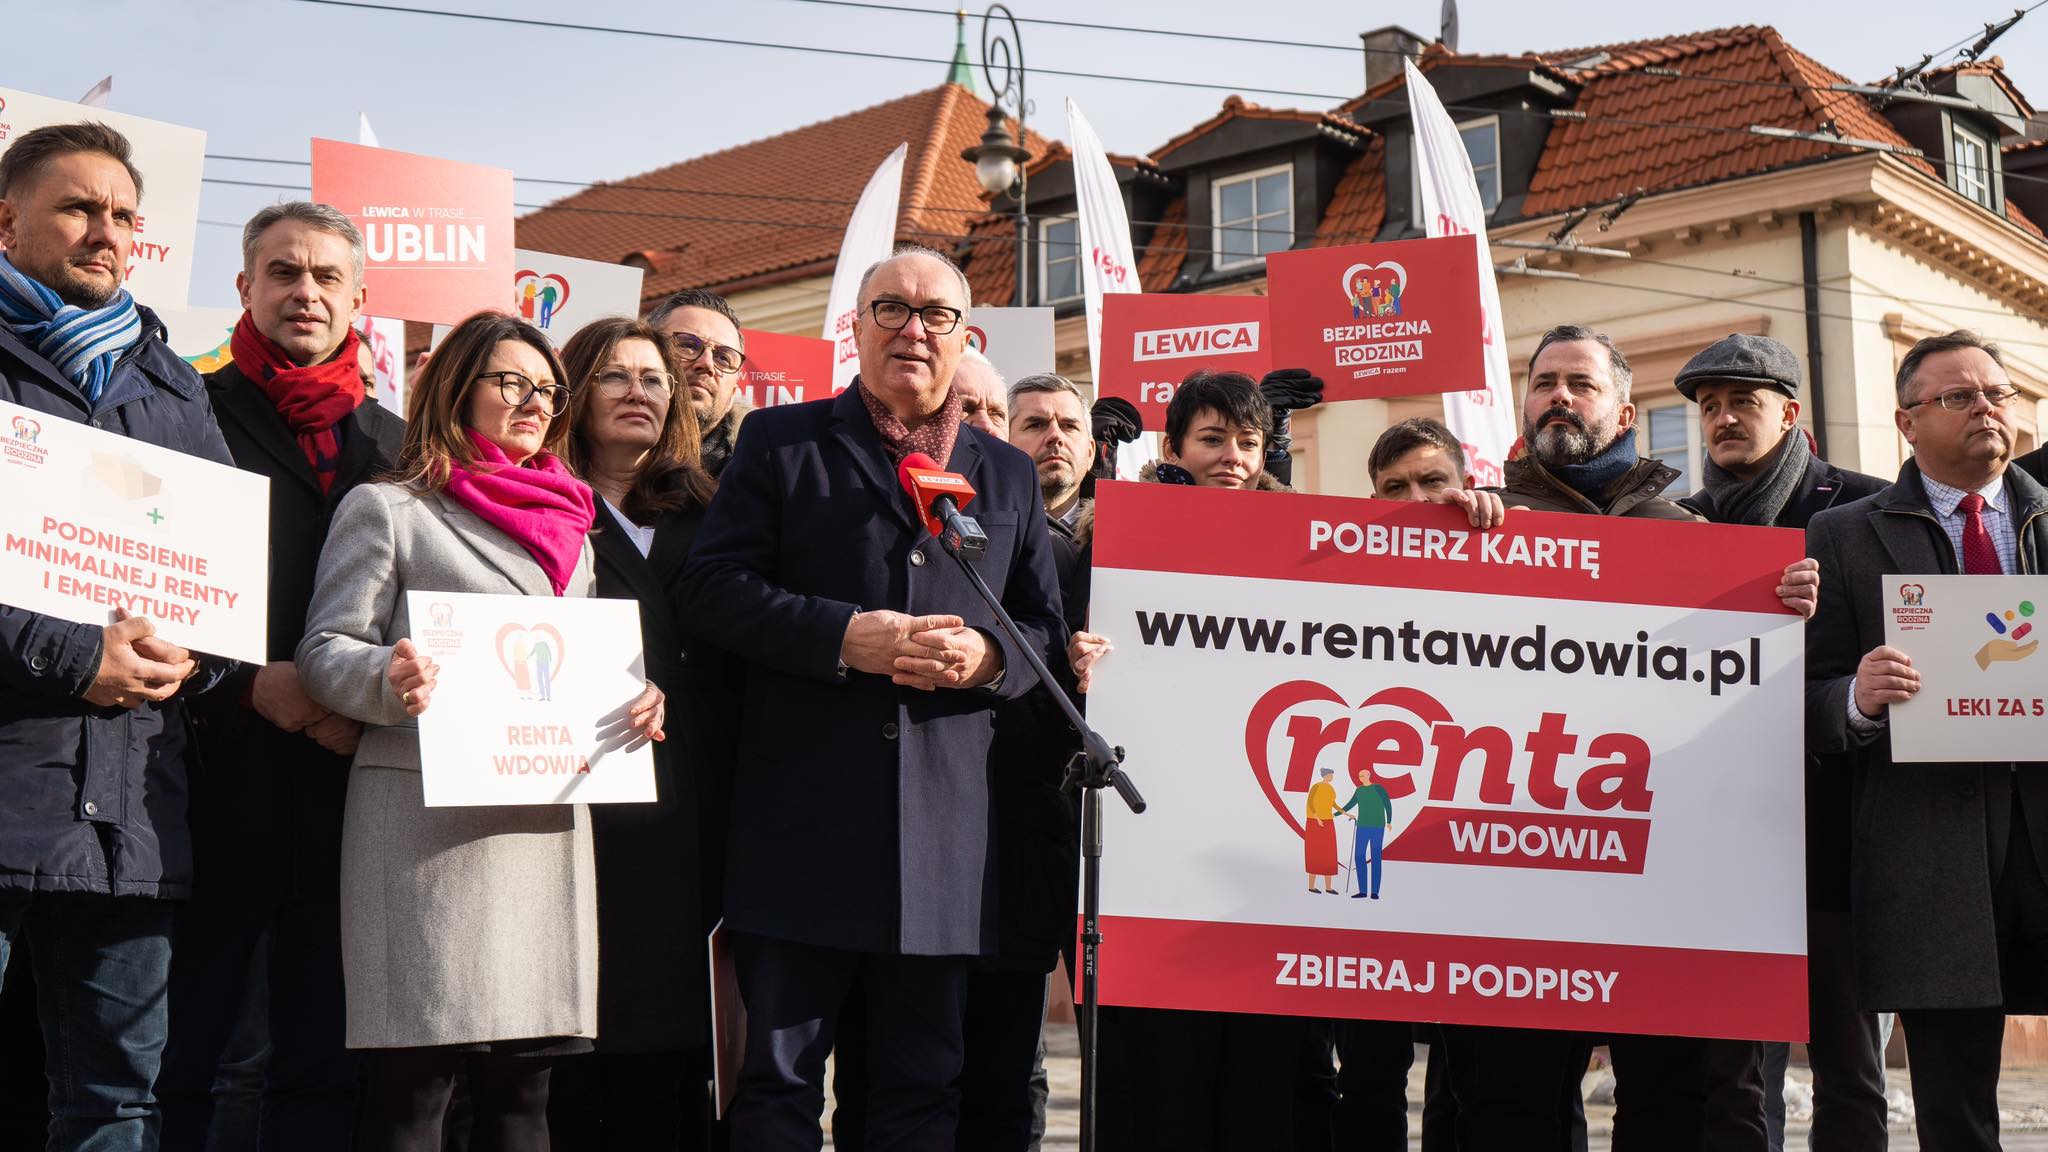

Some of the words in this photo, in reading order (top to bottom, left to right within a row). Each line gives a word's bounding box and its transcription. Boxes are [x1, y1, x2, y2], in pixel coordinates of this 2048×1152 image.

[362, 206, 409, 218] LEWICA
[412, 207, 425, 219] W
[429, 207, 465, 219] TRASIE
[130, 240, 170, 263] NTY
[366, 223, 486, 262] UBLIN
[1141, 327, 1252, 356] LEWICA
[1323, 319, 1432, 342] BEZPIECZNA
[1339, 343, 1420, 363] RODZINA
[750, 371, 787, 382] TRASIE
[1355, 368, 1379, 378] LEWICA
[1383, 366, 1407, 375] razem
[1140, 381, 1180, 403] ra
[42, 516, 208, 577] PODNIESIENIE
[1309, 520, 1469, 561] POBIERZ
[1481, 532, 1600, 579] KARTĘ
[6, 533, 157, 589] MINIMALNEJ
[164, 575, 239, 609] RENTY
[43, 571, 50, 589] I
[58, 574, 201, 626] EMERYTURY
[1135, 609, 1761, 696] www.rentawdowia.pl
[1947, 698, 1991, 716] LEKI
[1997, 698, 2026, 716] ZA
[2032, 698, 2045, 717] 5
[508, 725, 573, 746] RENTA
[492, 754, 591, 775] WDOWIA
[1283, 712, 1654, 813] renta
[1448, 820, 1627, 862] WDOWIA
[1275, 952, 1435, 994] ZBIERAJ
[1448, 962, 1620, 1003] PODPISY
